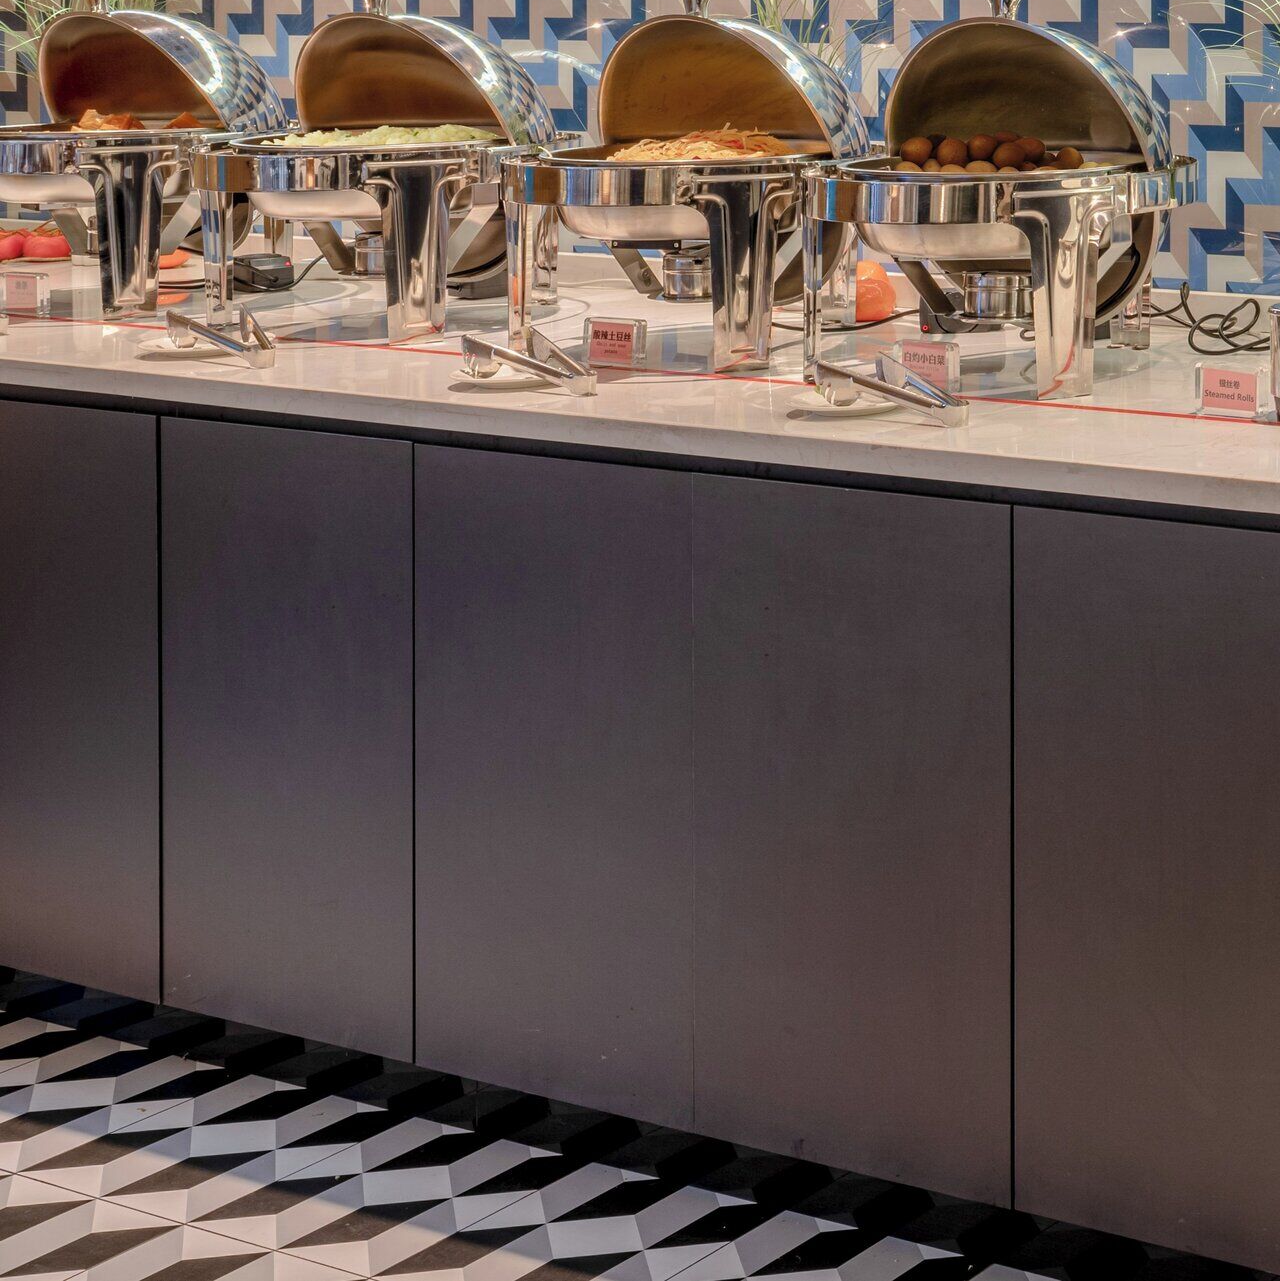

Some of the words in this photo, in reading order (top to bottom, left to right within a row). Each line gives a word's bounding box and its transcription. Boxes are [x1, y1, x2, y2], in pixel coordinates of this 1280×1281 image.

[592, 329, 632, 342] 酸辣土豆丝
[904, 351, 945, 366] 白灼小白菜
[1204, 389, 1235, 401] Steamed
[1237, 393, 1255, 403] Rolls
